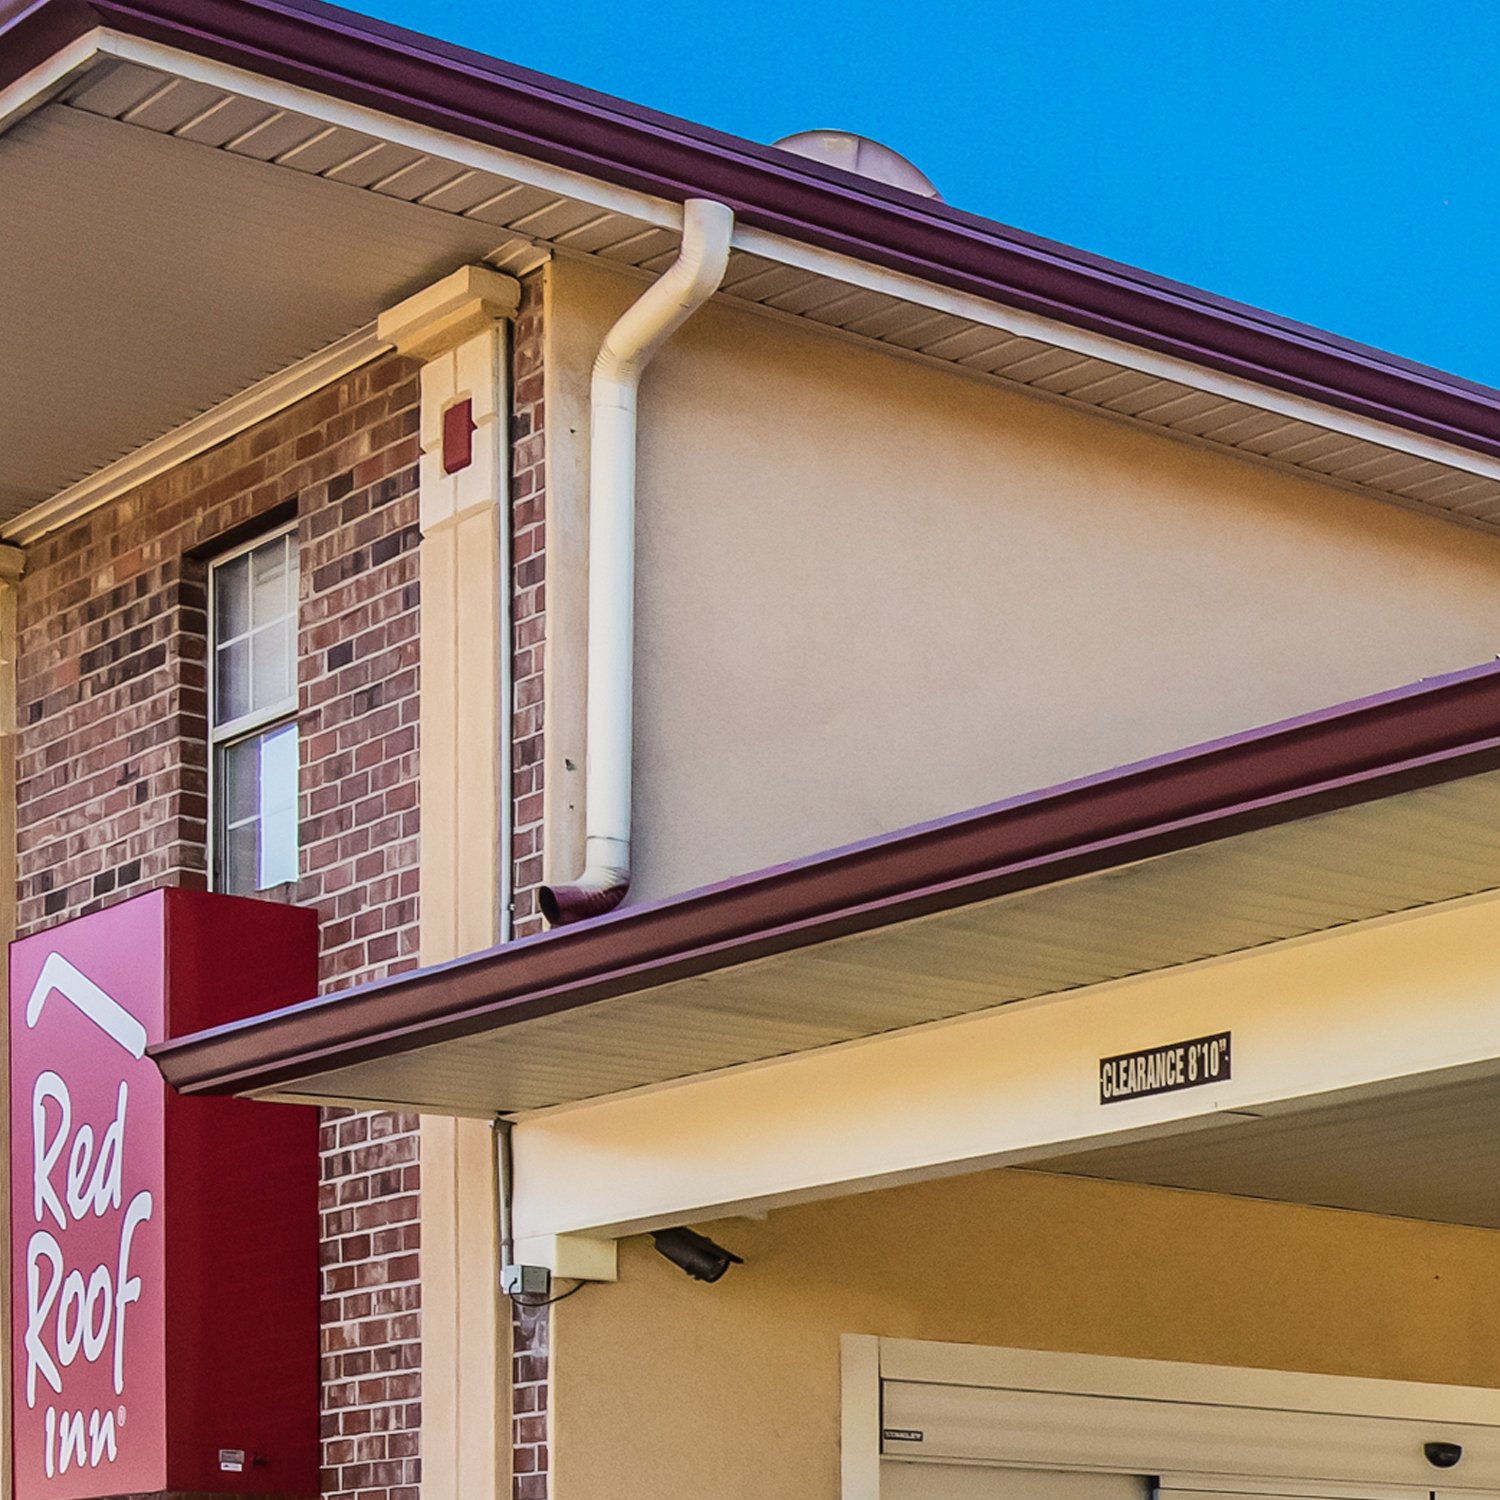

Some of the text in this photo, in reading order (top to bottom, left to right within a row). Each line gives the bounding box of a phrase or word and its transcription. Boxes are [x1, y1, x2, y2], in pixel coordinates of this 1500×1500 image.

[1102, 1038, 1228, 1098] CLEARANCE 8'10"
[32, 1069, 129, 1230] Red
[24, 1190, 153, 1410] Roof
